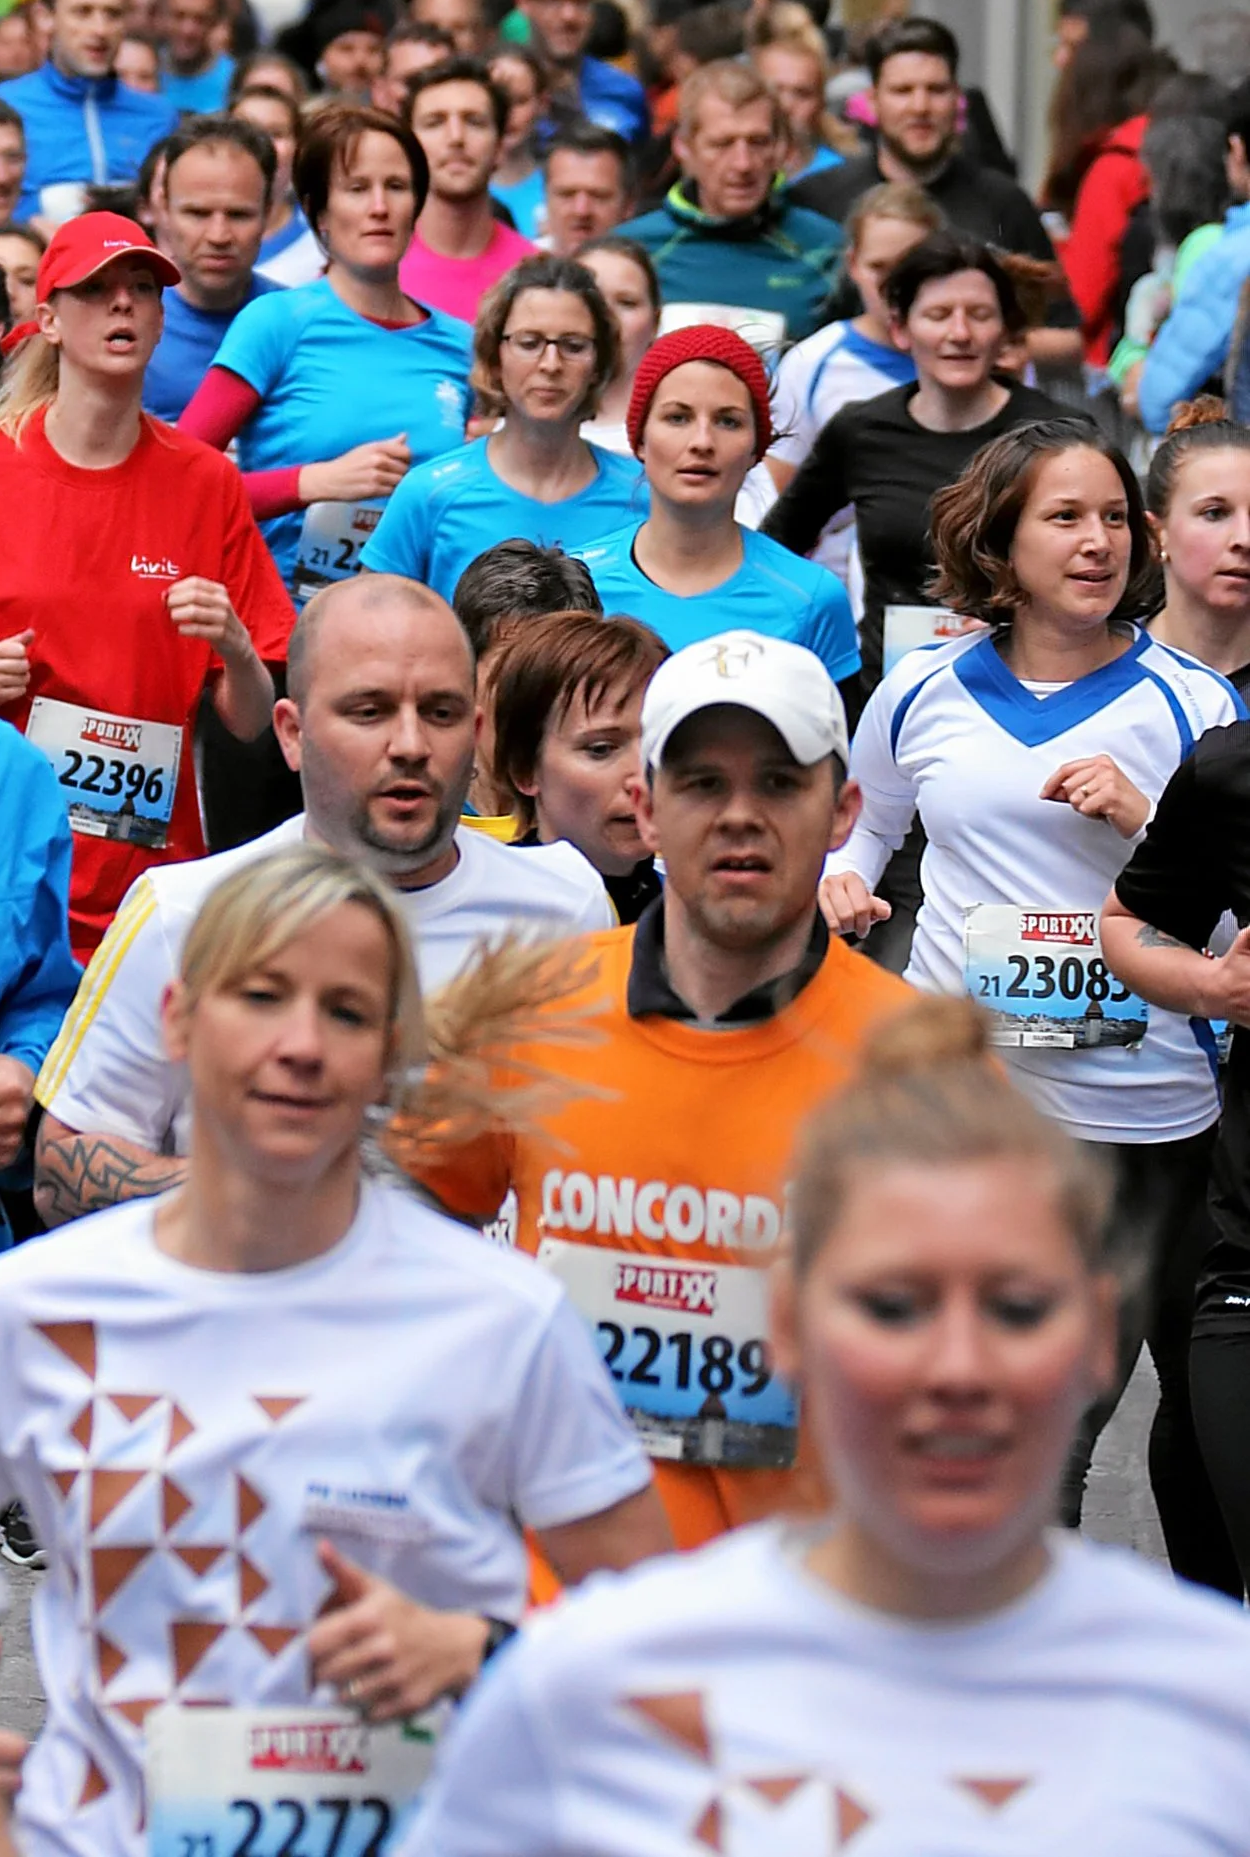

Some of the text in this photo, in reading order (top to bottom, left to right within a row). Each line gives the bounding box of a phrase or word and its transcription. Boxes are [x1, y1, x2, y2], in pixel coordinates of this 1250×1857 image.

[59, 750, 163, 804] 22396
[1018, 915, 1096, 941] SPORTXX
[979, 975, 1000, 997] 21
[614, 1265, 717, 1311] SPORTXX
[597, 1321, 775, 1398] 22189
[229, 1796, 392, 1857] 2272
